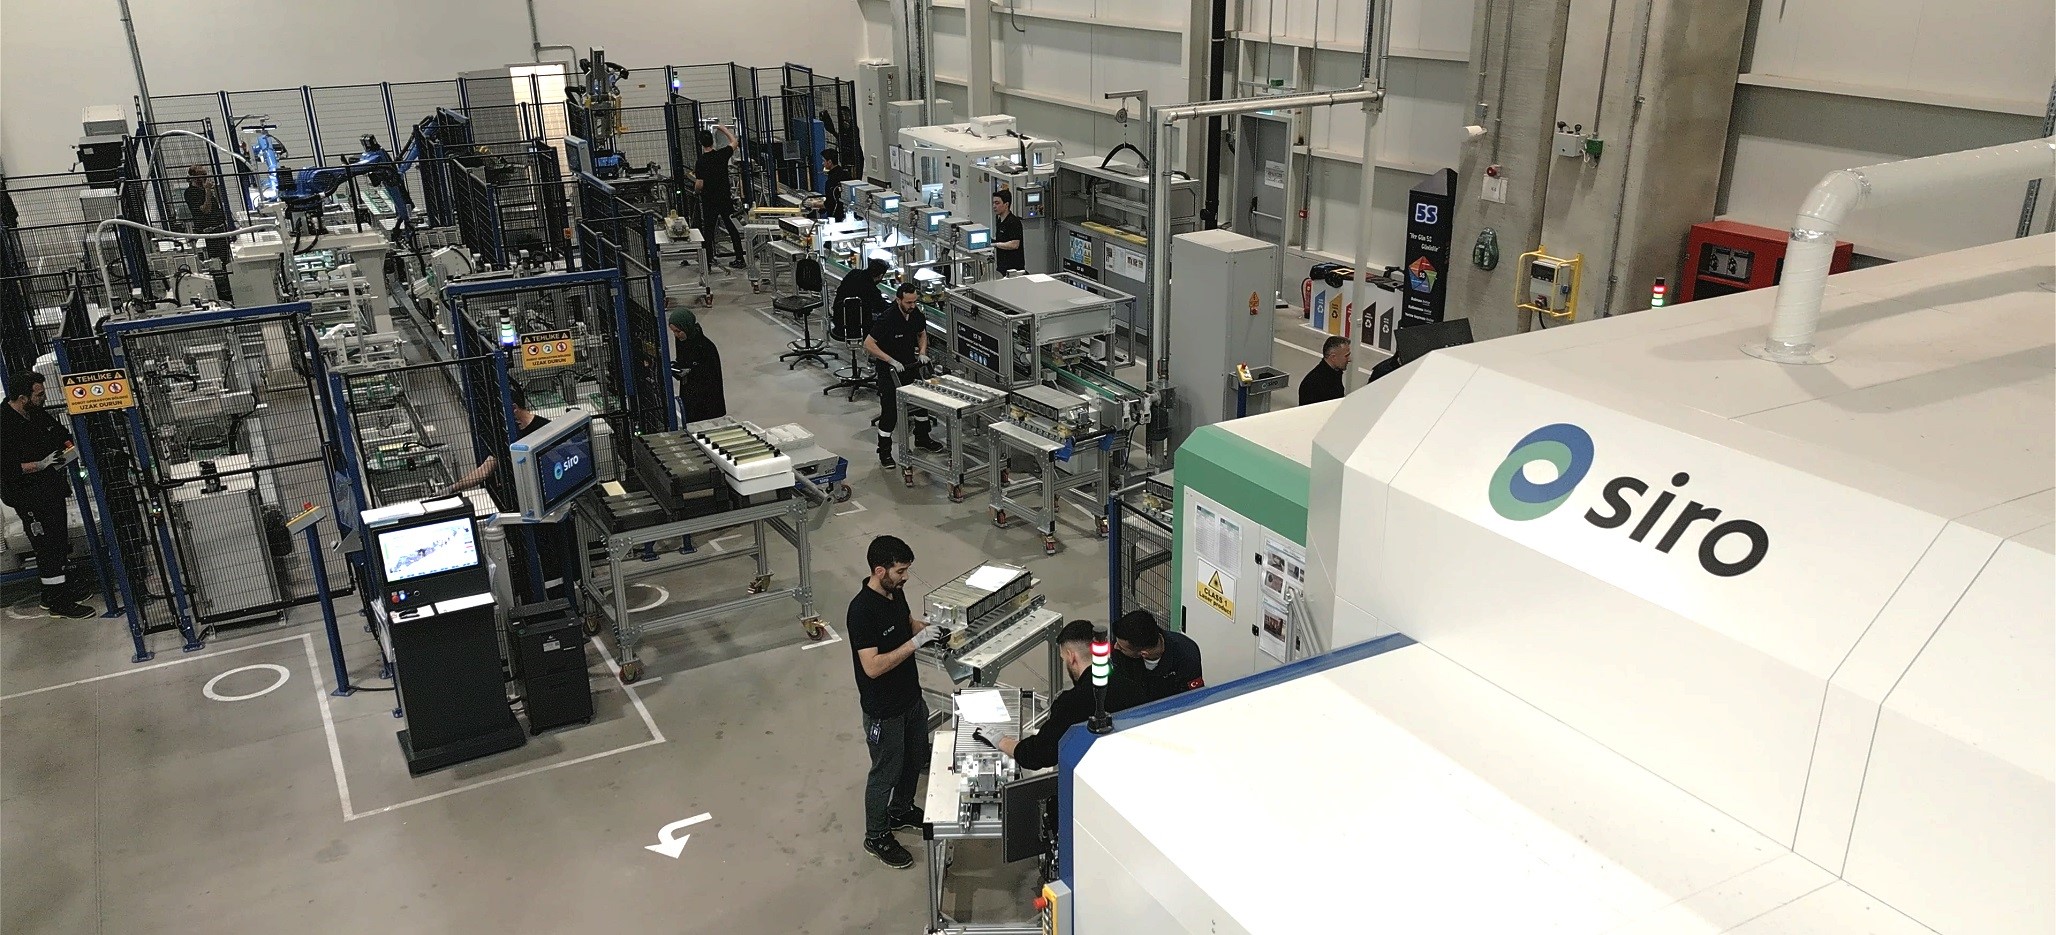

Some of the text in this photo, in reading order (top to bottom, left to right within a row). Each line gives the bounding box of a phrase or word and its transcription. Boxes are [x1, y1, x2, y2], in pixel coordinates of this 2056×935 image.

[1415, 203, 1438, 225] 5S
[79, 400, 123, 410] UZAK DURUN
[563, 455, 579, 471] siro
[1583, 471, 1769, 577] siro
[1199, 590, 1232, 617] Laser product
[1203, 587, 1223, 604] CLASS
